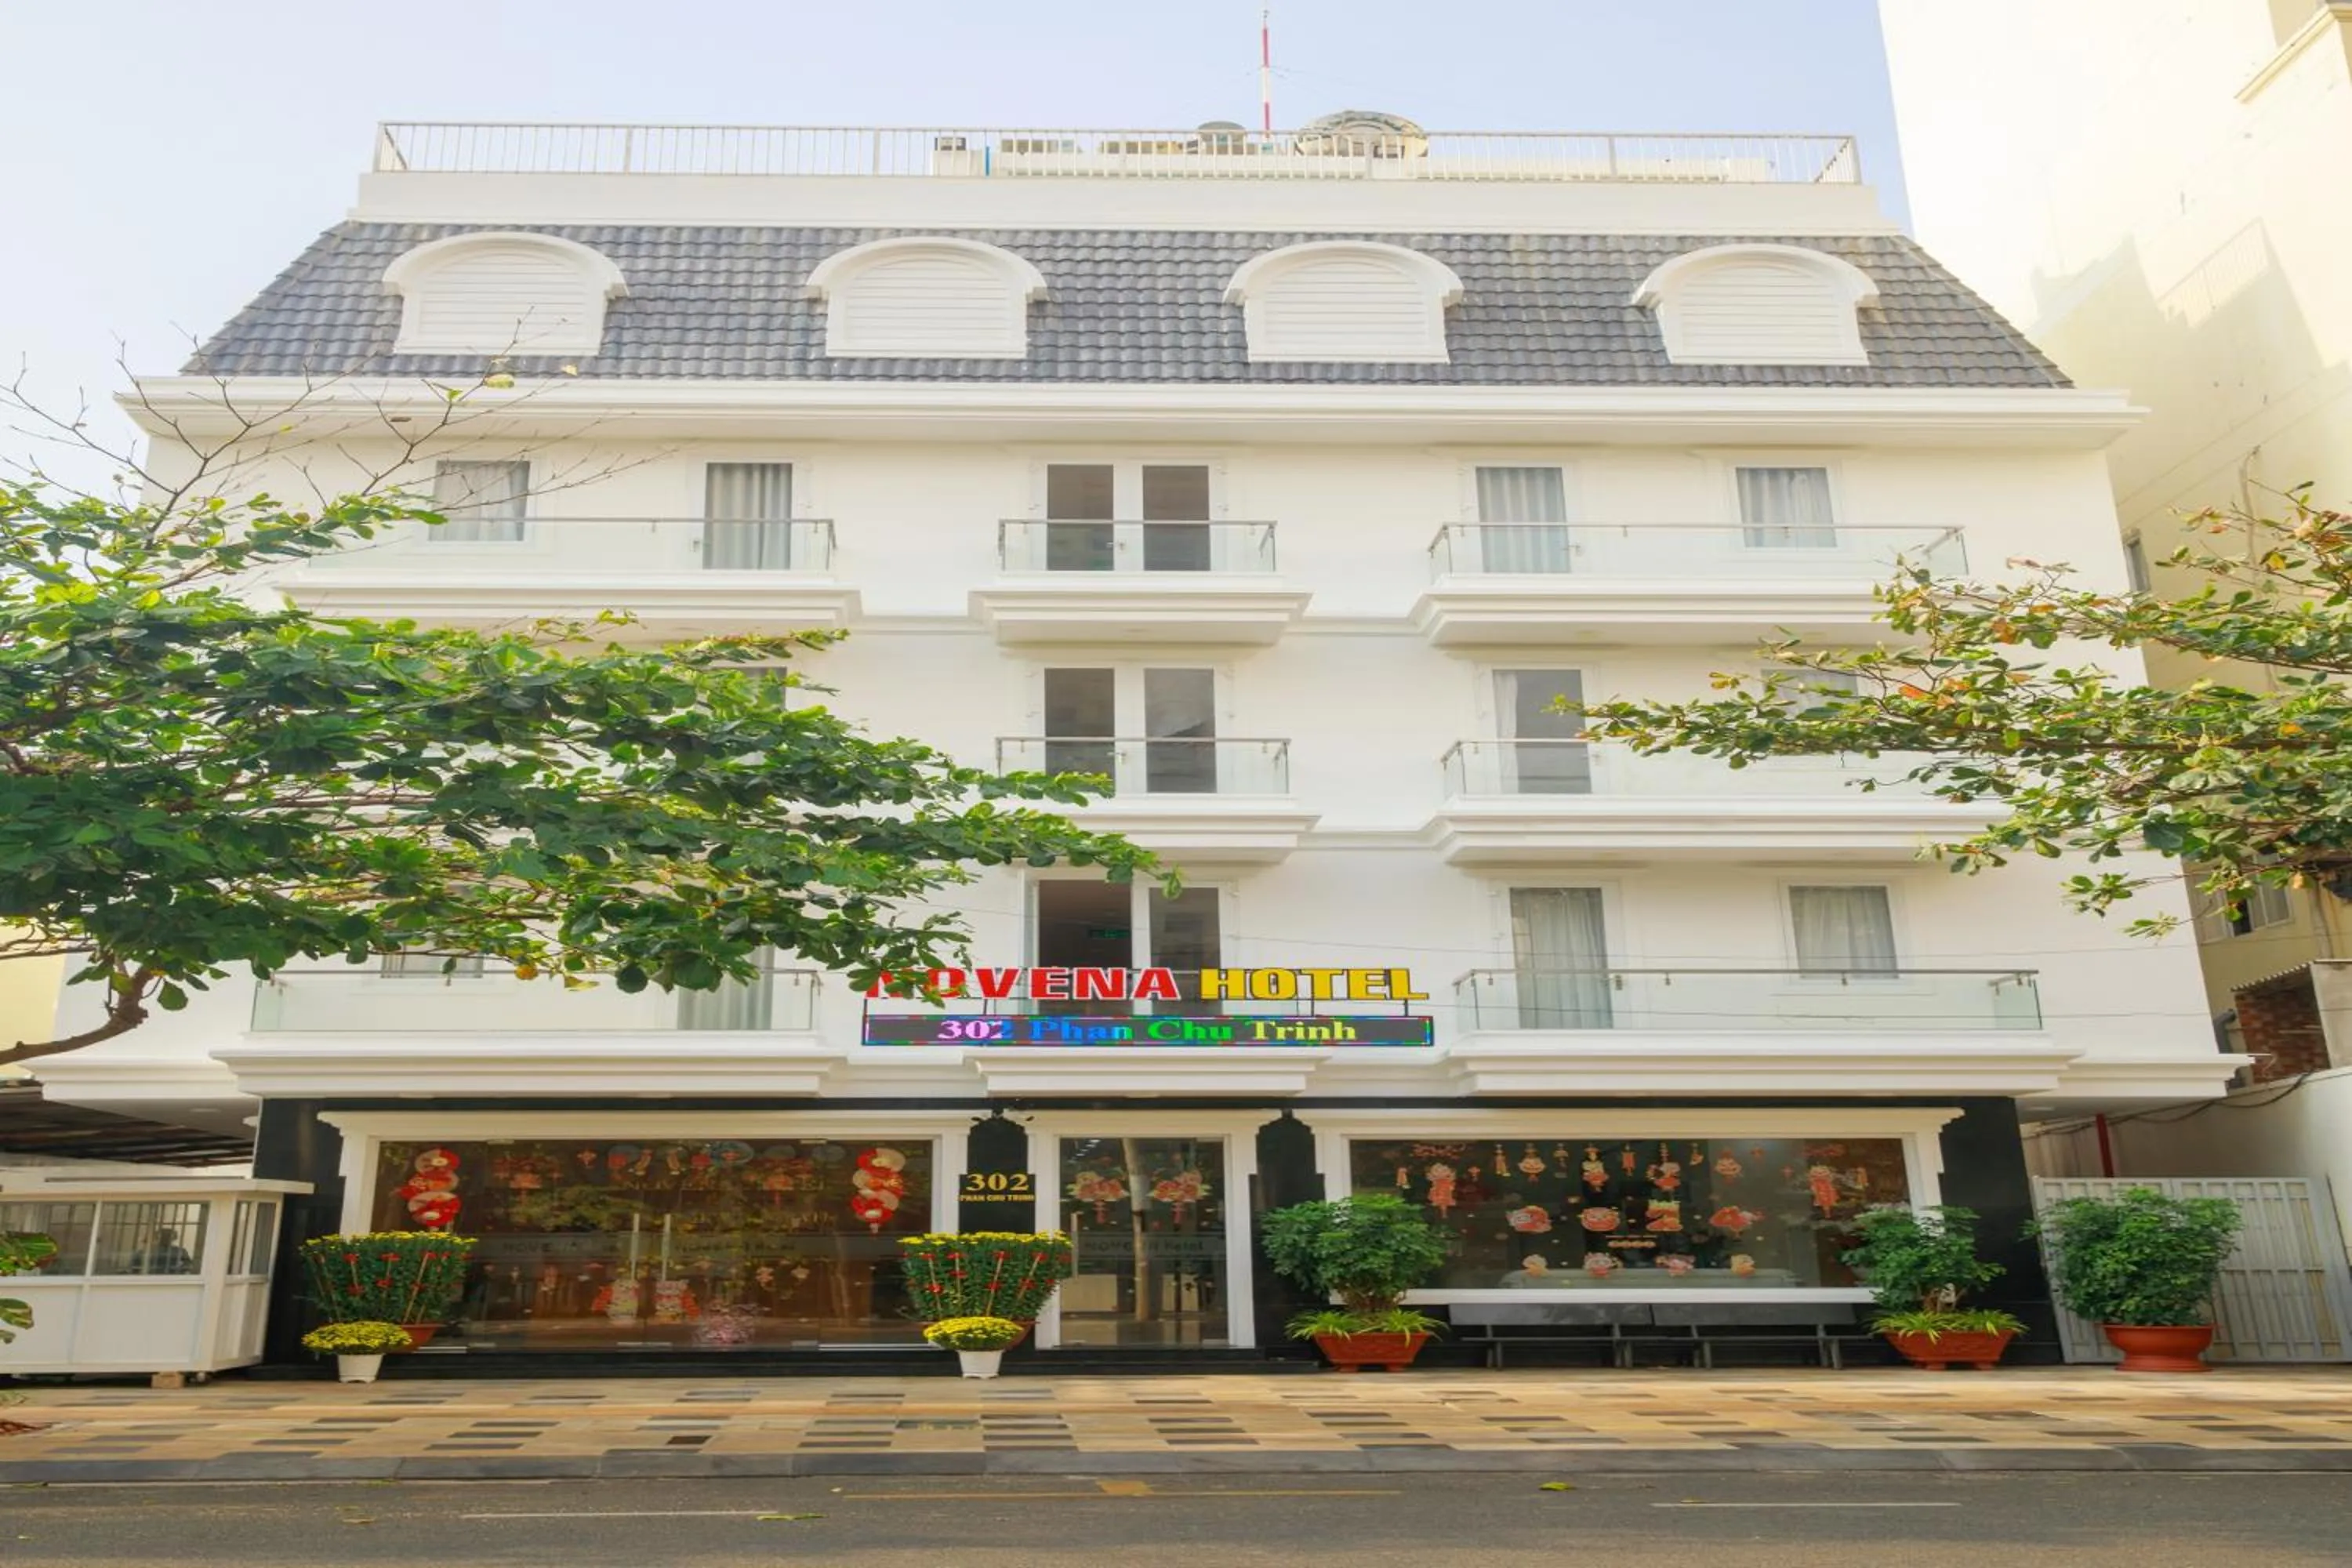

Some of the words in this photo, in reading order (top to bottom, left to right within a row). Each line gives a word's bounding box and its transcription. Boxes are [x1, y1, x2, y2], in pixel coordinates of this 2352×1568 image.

[1199, 967, 1430, 1000] HOTEL
[937, 1020, 1011, 1040] 302
[1029, 1020, 1134, 1040] Phan
[1147, 1020, 1234, 1040] Chu
[1245, 1020, 1358, 1040] Trinh
[965, 1173, 1029, 1192] 302
